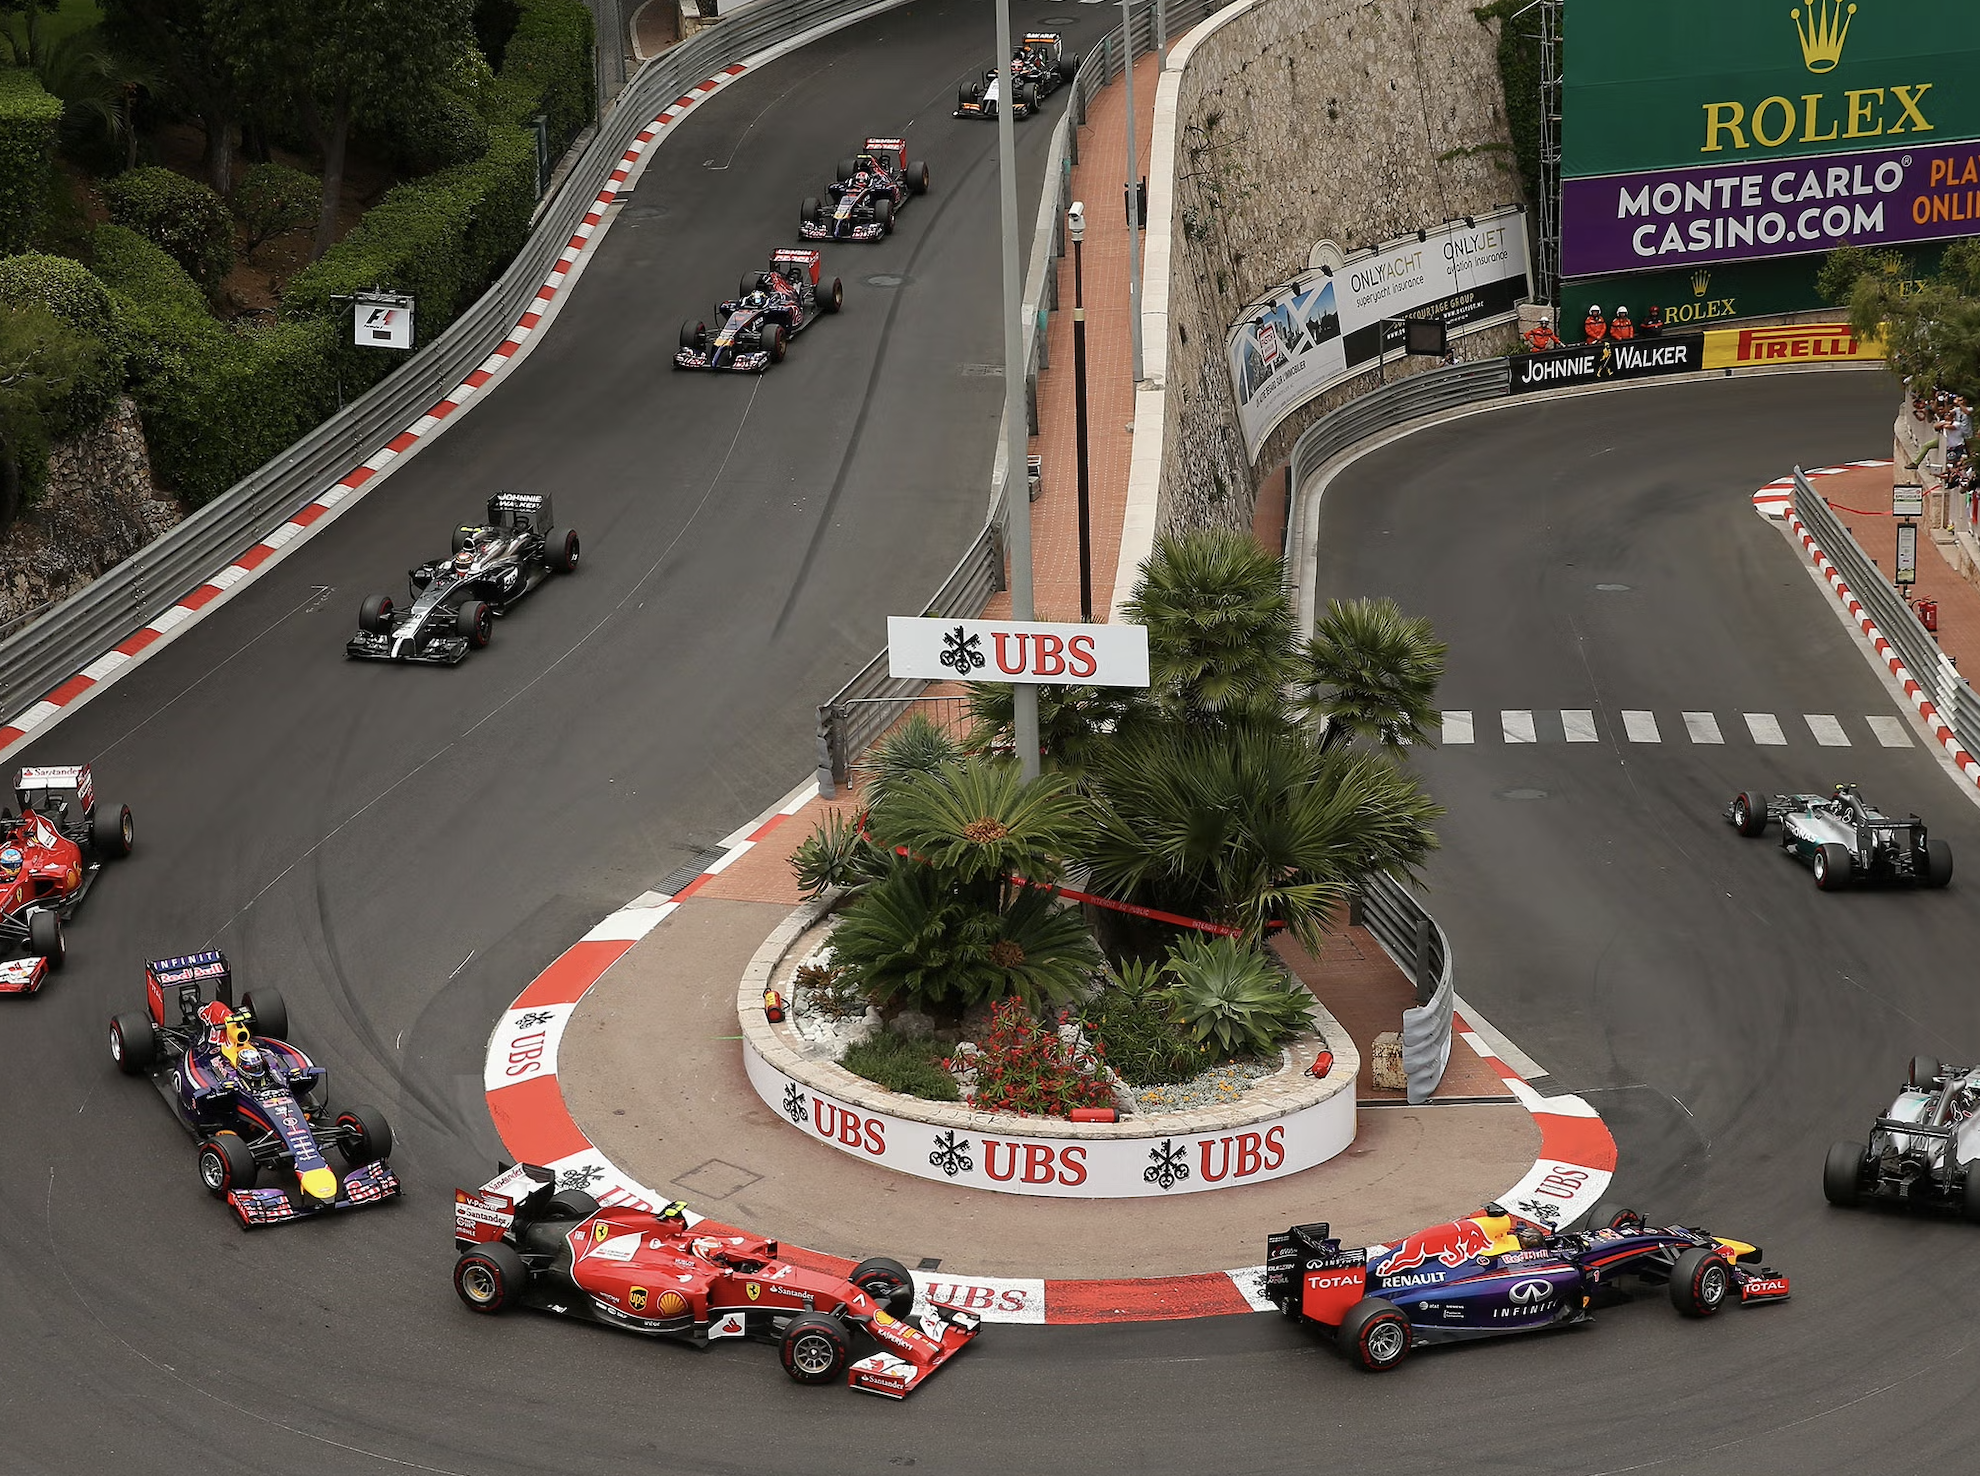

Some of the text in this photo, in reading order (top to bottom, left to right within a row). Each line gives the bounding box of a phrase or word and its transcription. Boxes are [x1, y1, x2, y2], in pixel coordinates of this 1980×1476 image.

[1700, 83, 1934, 152] ROLEX
[1930, 154, 1980, 188] PLA
[1617, 174, 1762, 219] MONTE
[1443, 227, 1506, 260] ONLYJET
[1632, 201, 1884, 257] CASINO.COM
[1450, 292, 1475, 309] GROUP
[1664, 298, 1737, 324] ROLEX
[1737, 324, 1859, 361] PIRELLI
[1522, 345, 1687, 383] JOHNNIE WALKER
[497, 493, 542, 502] JOHNNIE
[991, 632, 1097, 677] UBS
[153, 951, 220, 970] INFINITI
[505, 1030, 546, 1076] UBS
[811, 1097, 888, 1155] UBS
[981, 1140, 1088, 1187] UBS
[1198, 1125, 1287, 1182] UBS
[489, 1168, 524, 1191] Santander
[1534, 1165, 1590, 1200] UBS
[466, 1198, 499, 1212] V-Power
[778, 1286, 815, 1301] Santander
[1308, 1275, 1363, 1289] TOTAL
[1382, 1271, 1446, 1288] RENAULT
[1745, 1281, 1785, 1292] TOTAL
[630, 1294, 646, 1307] ups
[852, 1293, 866, 1307] 7
[925, 1281, 1027, 1313] UBS
[1493, 1299, 1559, 1318] INFINITI
[868, 1376, 905, 1390] Santander
